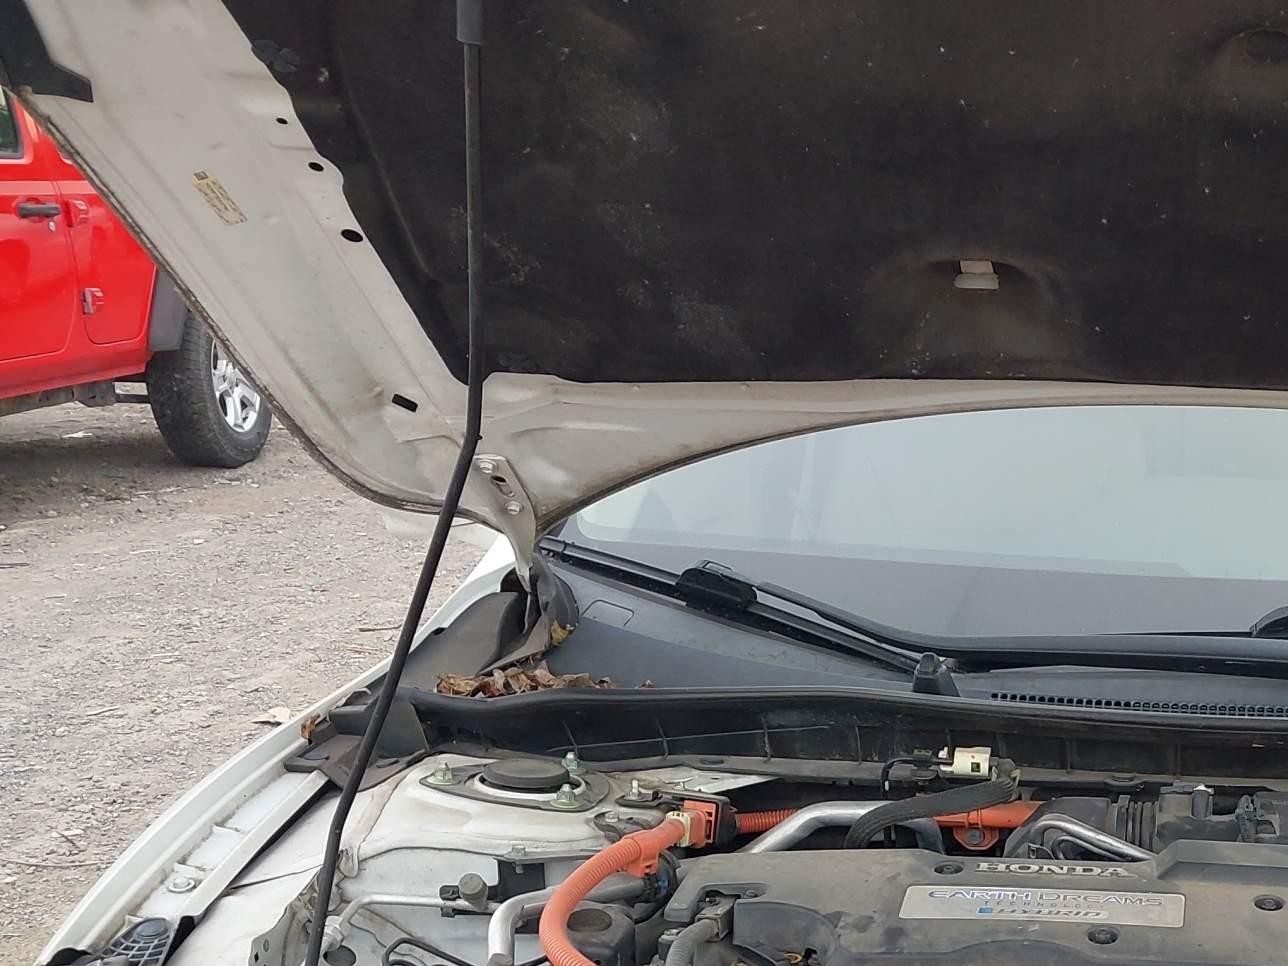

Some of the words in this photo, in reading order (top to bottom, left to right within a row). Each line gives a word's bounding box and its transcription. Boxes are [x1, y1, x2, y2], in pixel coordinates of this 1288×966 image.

[976, 862, 1137, 878] HONDA
[928, 889, 1031, 902] EARTH
[994, 908, 1108, 917] HYBRID
